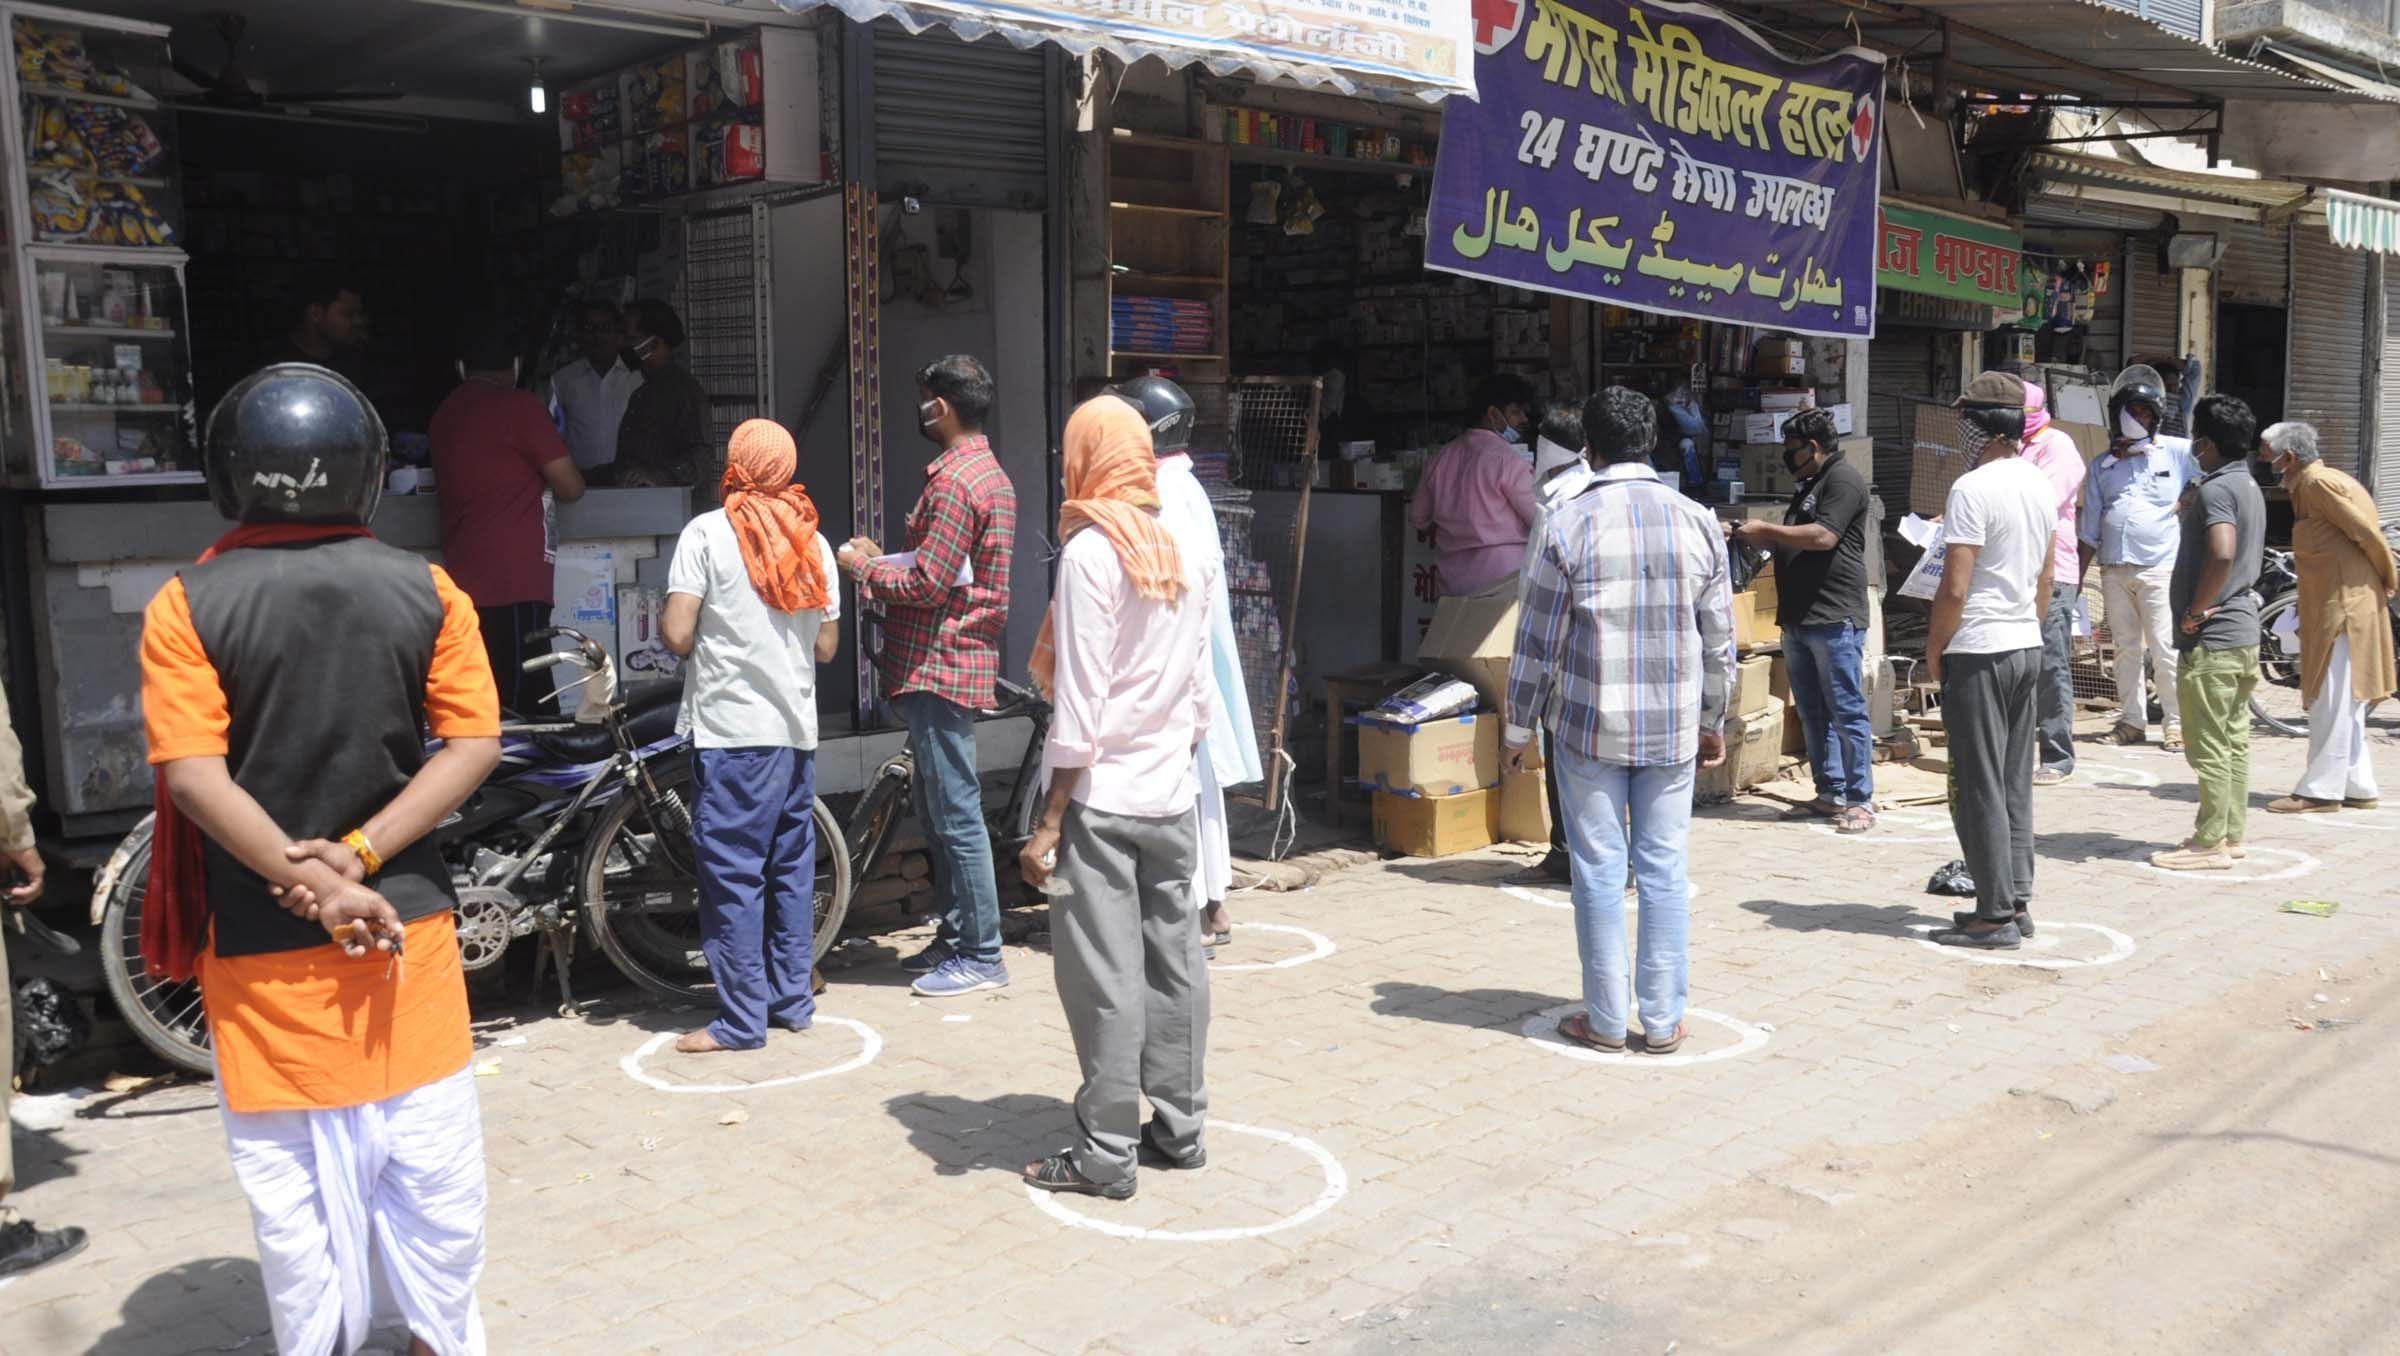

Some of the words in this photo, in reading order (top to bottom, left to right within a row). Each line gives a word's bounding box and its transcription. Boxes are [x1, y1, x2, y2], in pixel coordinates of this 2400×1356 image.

[1525, 0, 1626, 105] भारत
[1627, 8, 1783, 150] मेडिकल
[1779, 82, 1853, 162] हाल
[1517, 110, 1565, 169] 24
[1573, 124, 1664, 193] घण्टे
[1670, 137, 1736, 212] सेवा
[1742, 170, 1836, 231] उपलब्ध
[1935, 233, 2021, 295] भण्डार
